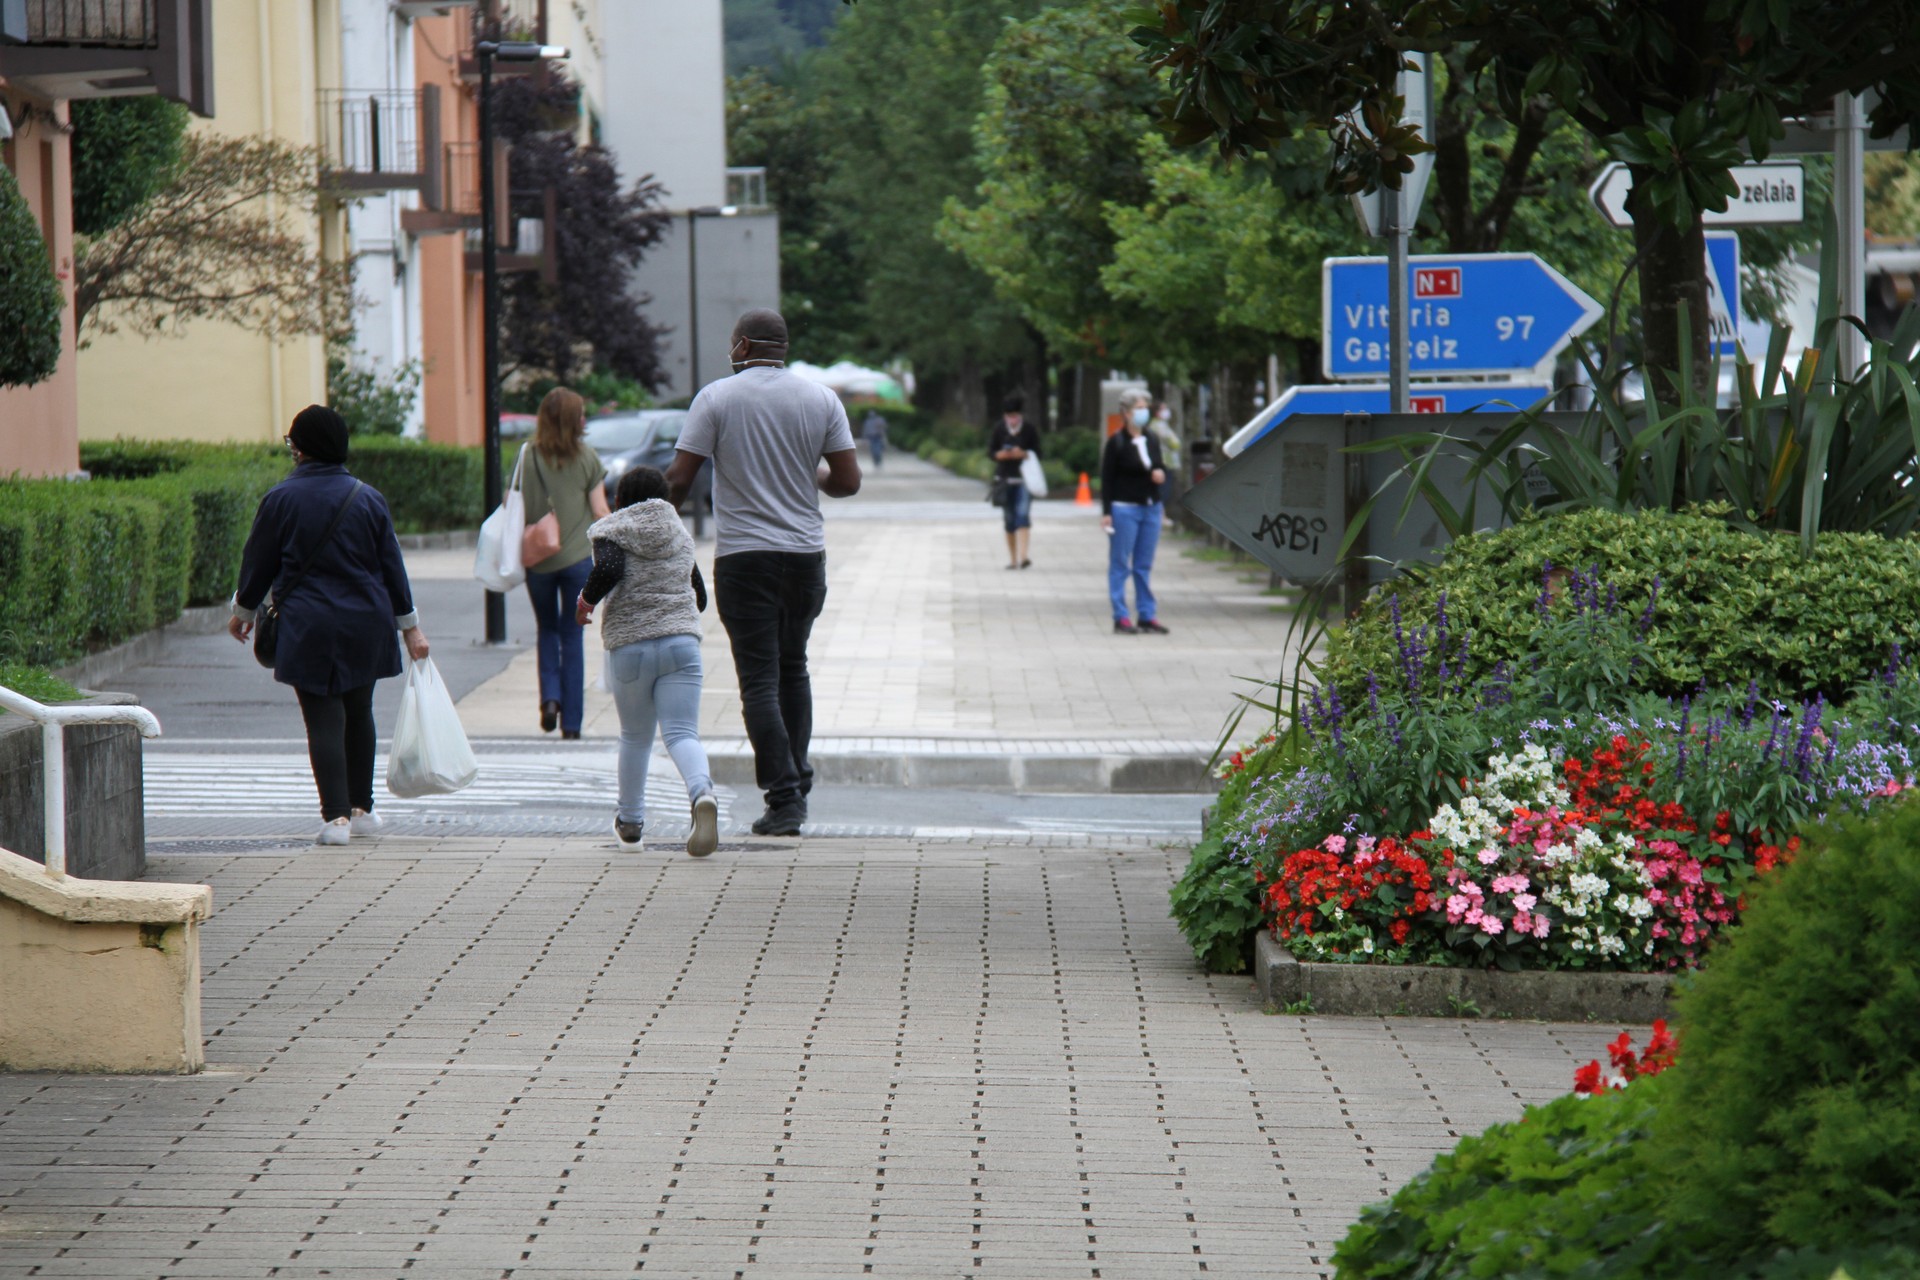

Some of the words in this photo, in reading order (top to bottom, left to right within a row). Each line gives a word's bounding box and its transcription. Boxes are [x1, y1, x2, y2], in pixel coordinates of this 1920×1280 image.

[1743, 179, 1796, 203] zelaia
[1345, 304, 1450, 329] Vitria
[1496, 315, 1535, 341] 97
[1344, 336, 1458, 362] Gaeiz
